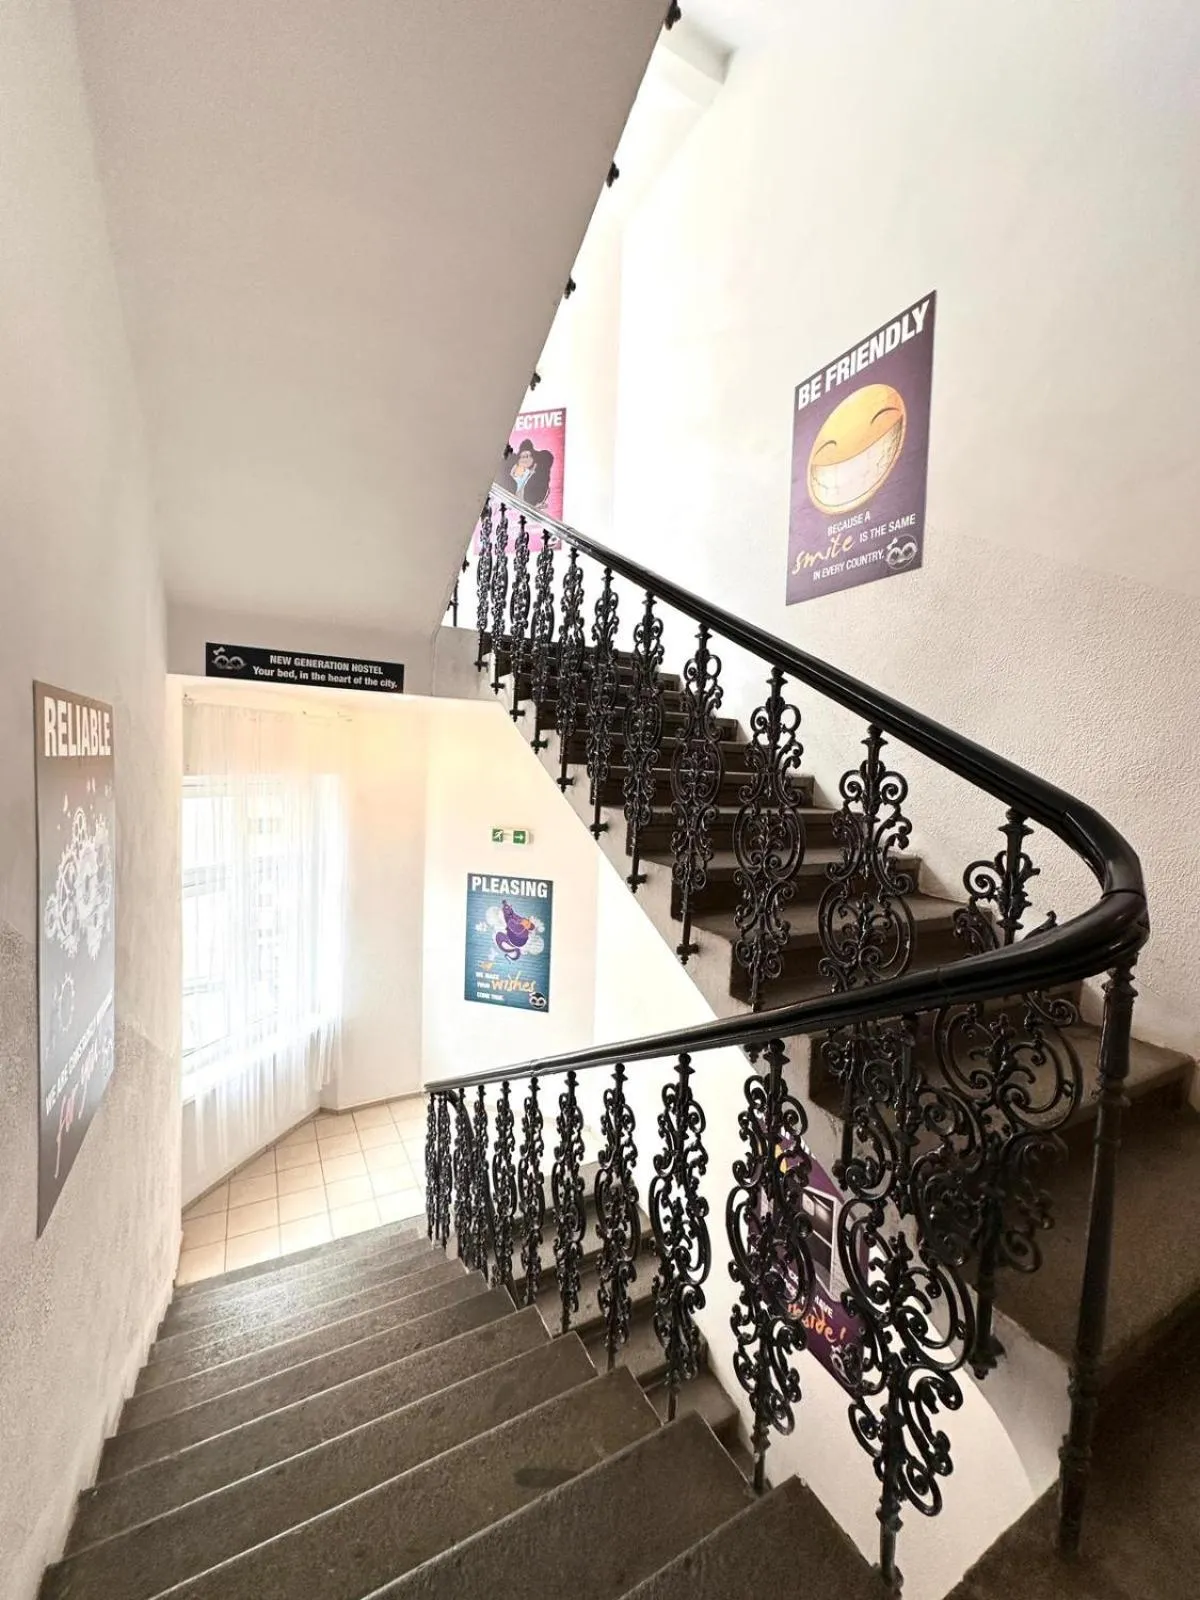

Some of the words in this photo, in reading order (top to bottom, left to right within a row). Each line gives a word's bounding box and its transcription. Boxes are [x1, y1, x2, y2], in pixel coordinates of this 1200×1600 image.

[798, 375, 821, 411] BE
[825, 300, 930, 393] FRIENDLY
[827, 513, 863, 537] BECAUSE
[865, 510, 871, 522] A
[859, 532, 868, 543] IS
[870, 523, 887, 539] THE
[888, 513, 916, 533] SAME
[813, 570, 821, 580] IN
[821, 564, 845, 578] EVERY
[252, 665, 275, 677] Your
[277, 666, 298, 680] bed,
[299, 670, 309, 680] in
[311, 670, 326, 682] the
[328, 673, 351, 685] heart
[353, 675, 363, 685] of
[364, 676, 378, 687] the
[269, 655, 292, 666] NEW
[294, 657, 349, 671] GENERATION
[351, 663, 384, 675] HOSTEL
[44, 696, 113, 757] RELIABLE
[471, 875, 548, 898] PLEASING
